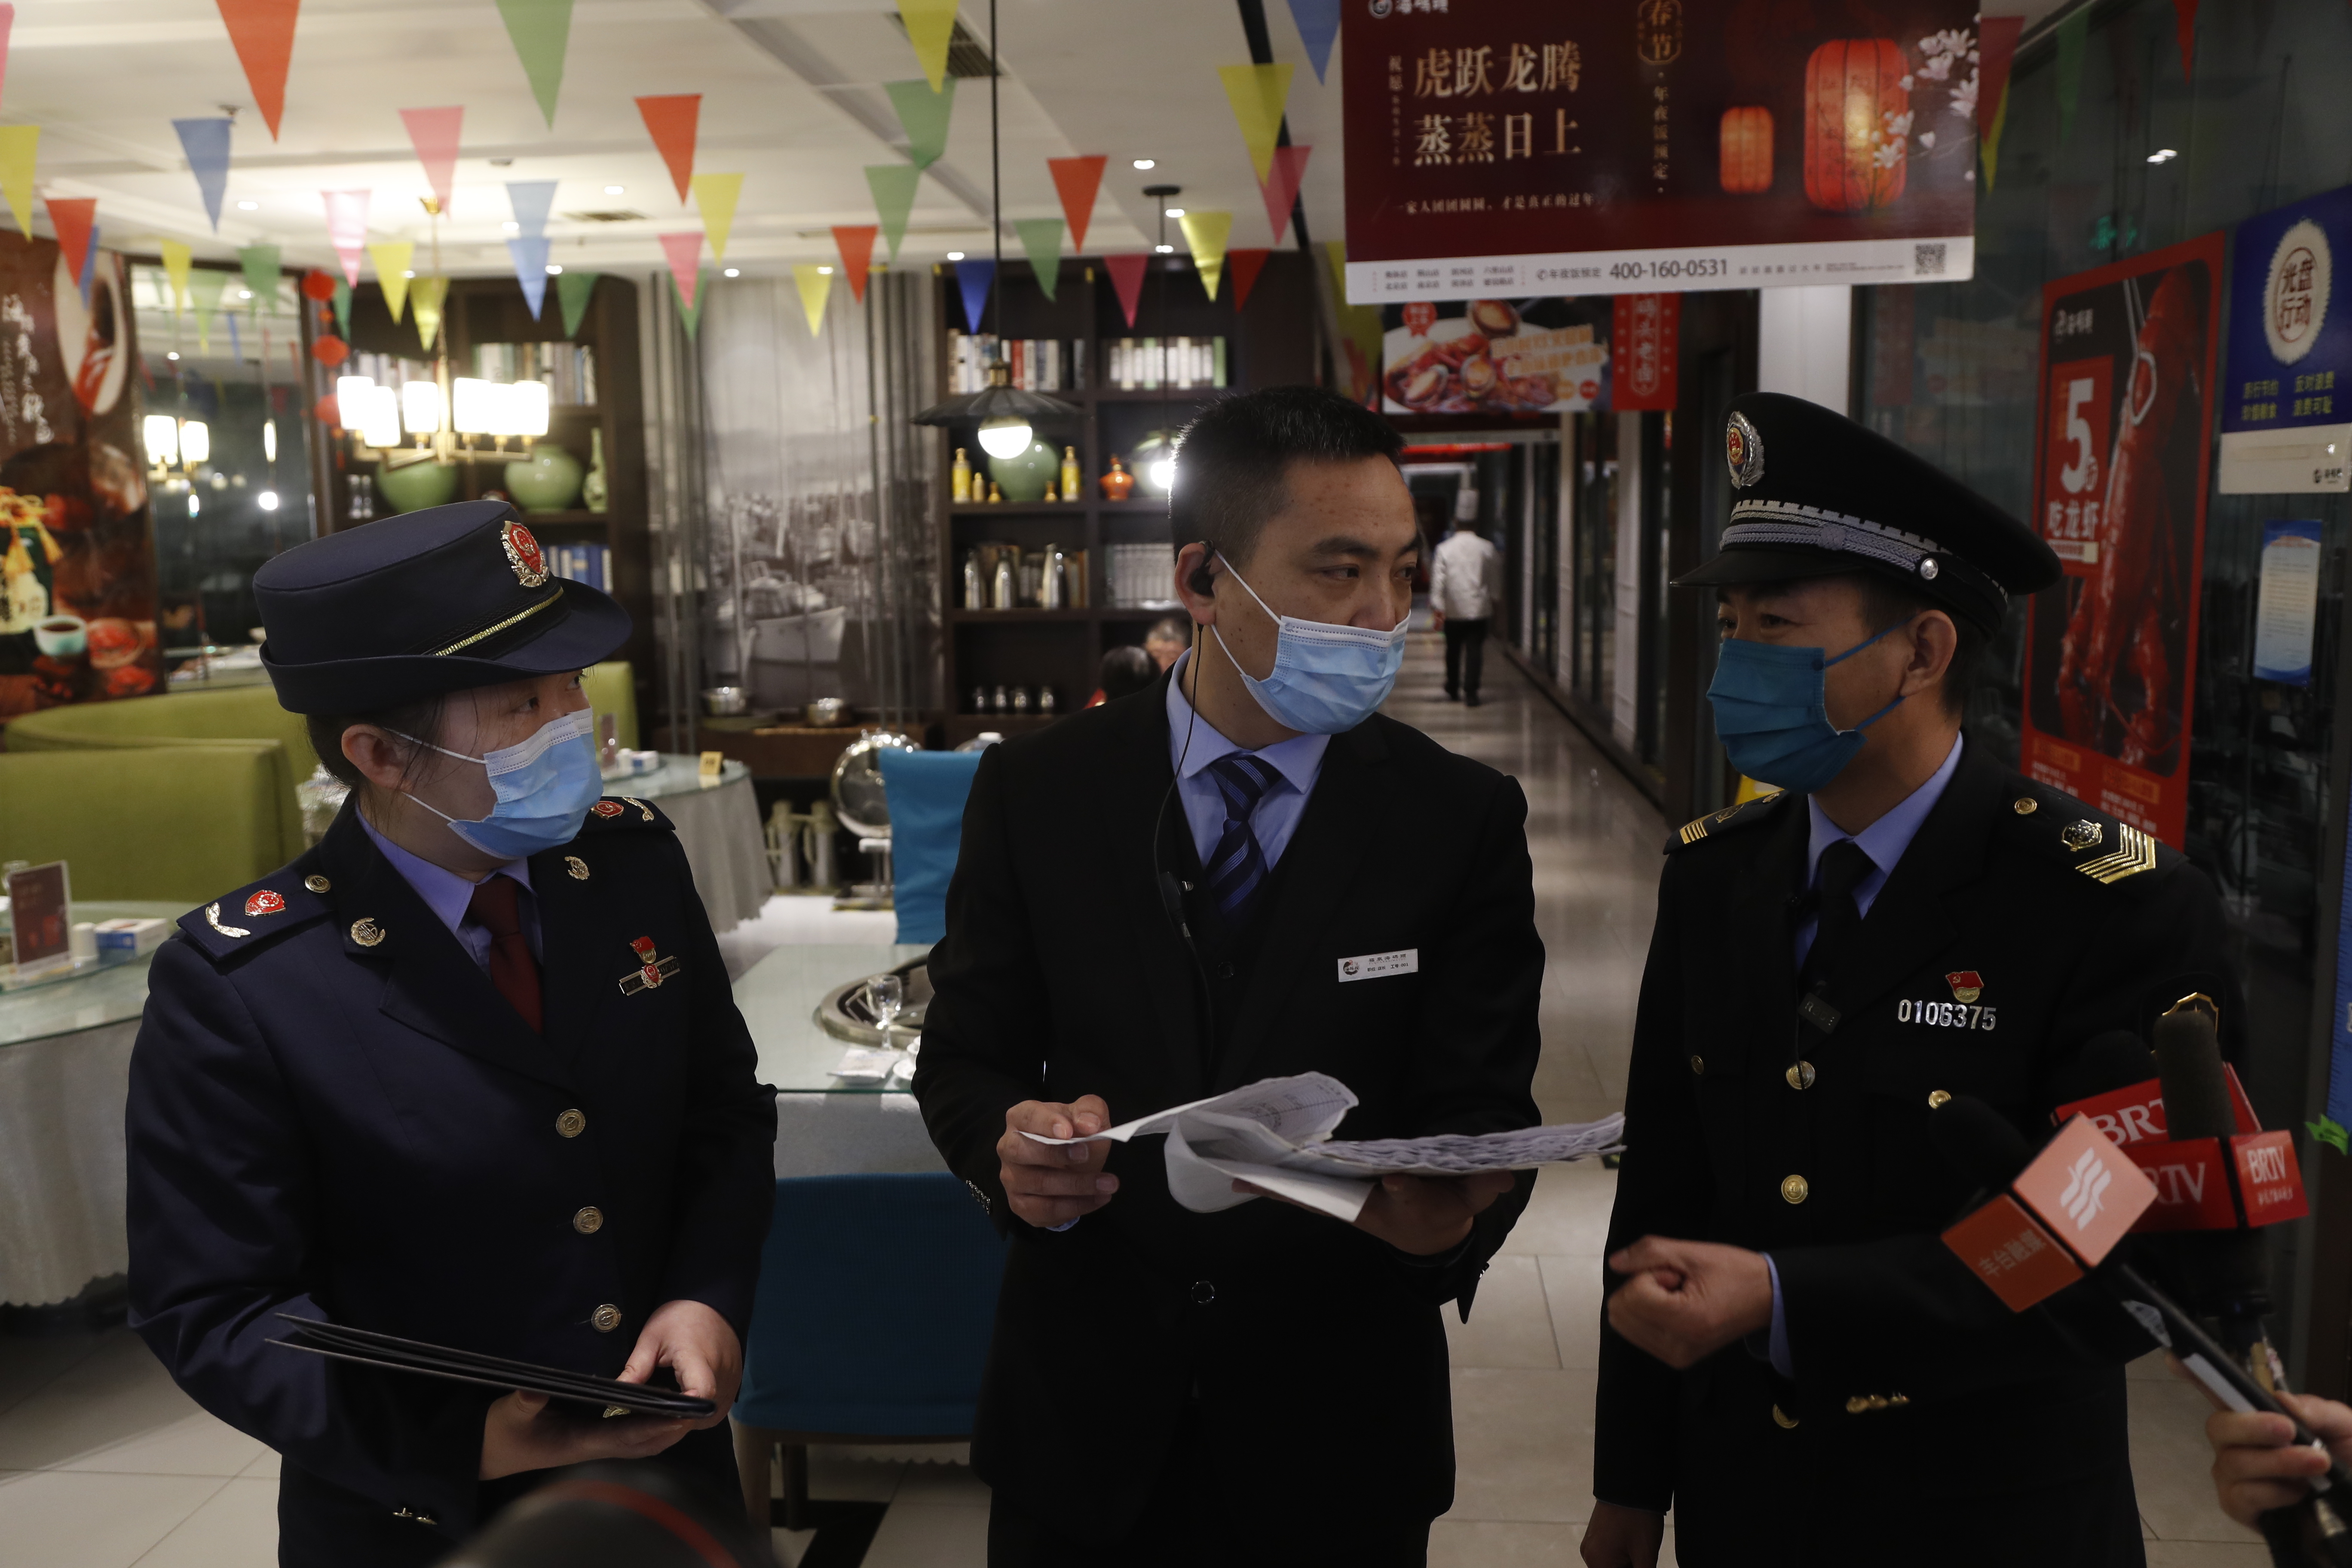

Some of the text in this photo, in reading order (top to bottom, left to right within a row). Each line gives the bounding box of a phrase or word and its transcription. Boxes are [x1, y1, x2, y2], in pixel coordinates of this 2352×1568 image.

[1414, 40, 1582, 99] 虎跃龙腾
[1414, 107, 1582, 166] 蒸蒸日上
[1609, 259, 1727, 279] 400-160-0531
[2280, 260, 2314, 293] 光盘
[2277, 297, 2312, 333] 行动
[2061, 377, 2095, 494] 5
[2047, 499, 2100, 541] 吃龙虾
[1898, 999, 1997, 1031] 0106375
[2247, 1145, 2287, 1185] BRTV
[1978, 1228, 2048, 1277] 丰台融媒
